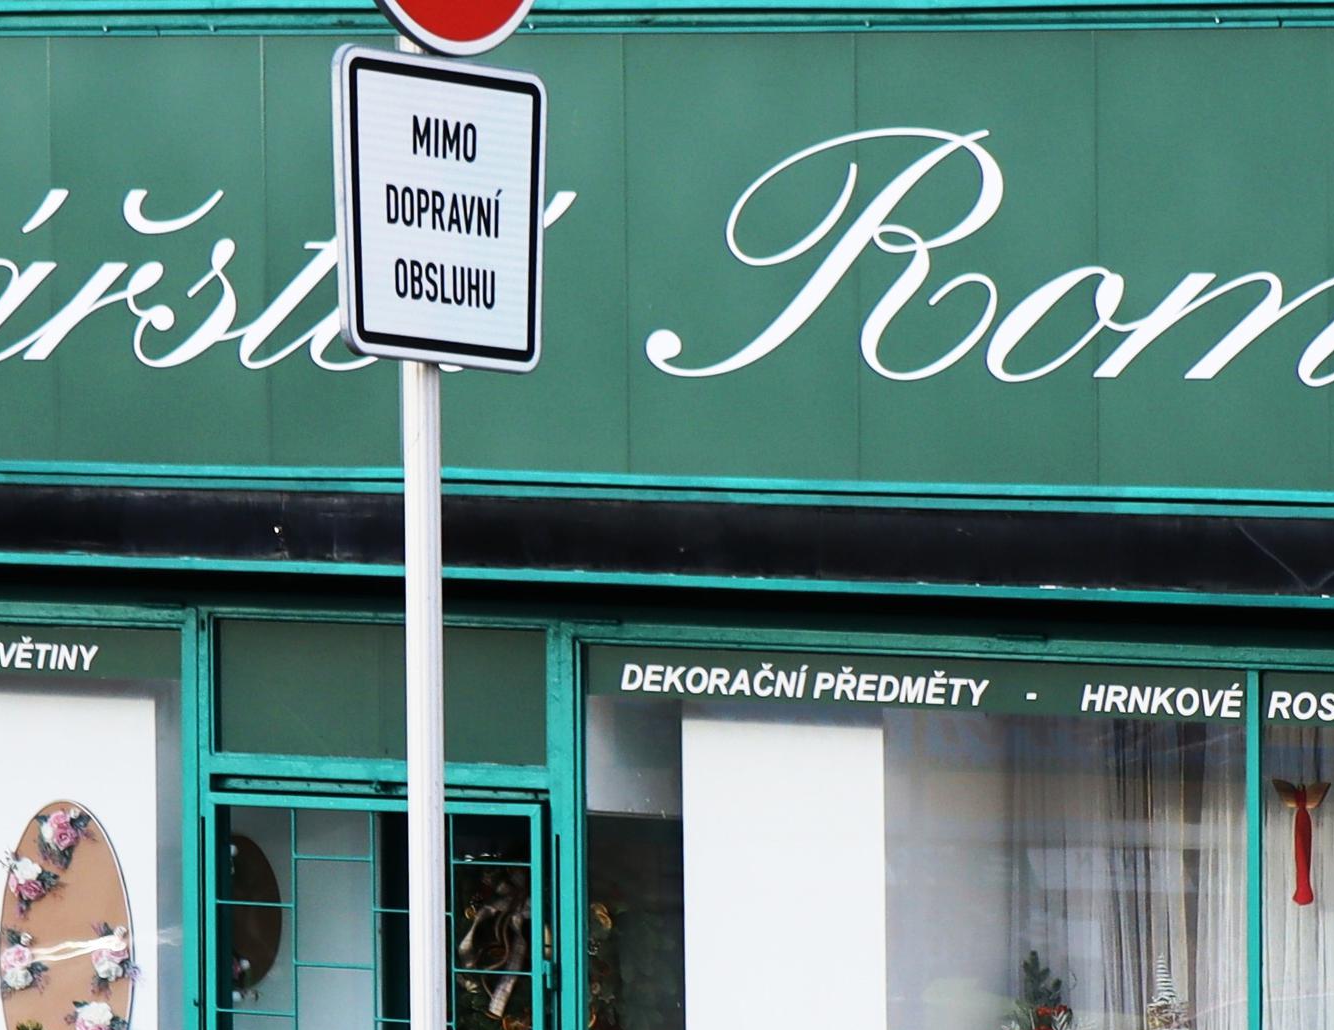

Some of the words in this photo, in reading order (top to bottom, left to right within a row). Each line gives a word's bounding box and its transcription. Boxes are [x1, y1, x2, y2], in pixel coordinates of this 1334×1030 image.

[411, 114, 478, 163] MIMO
[385, 183, 503, 239] DOPRAVNÍ
[393, 257, 496, 310] OBSLUHU
[620, 661, 809, 698] DEKORAČNÍ
[812, 666, 990, 706] PŘEDMĚTY
[1080, 682, 1244, 718] HRNKOVÉ
